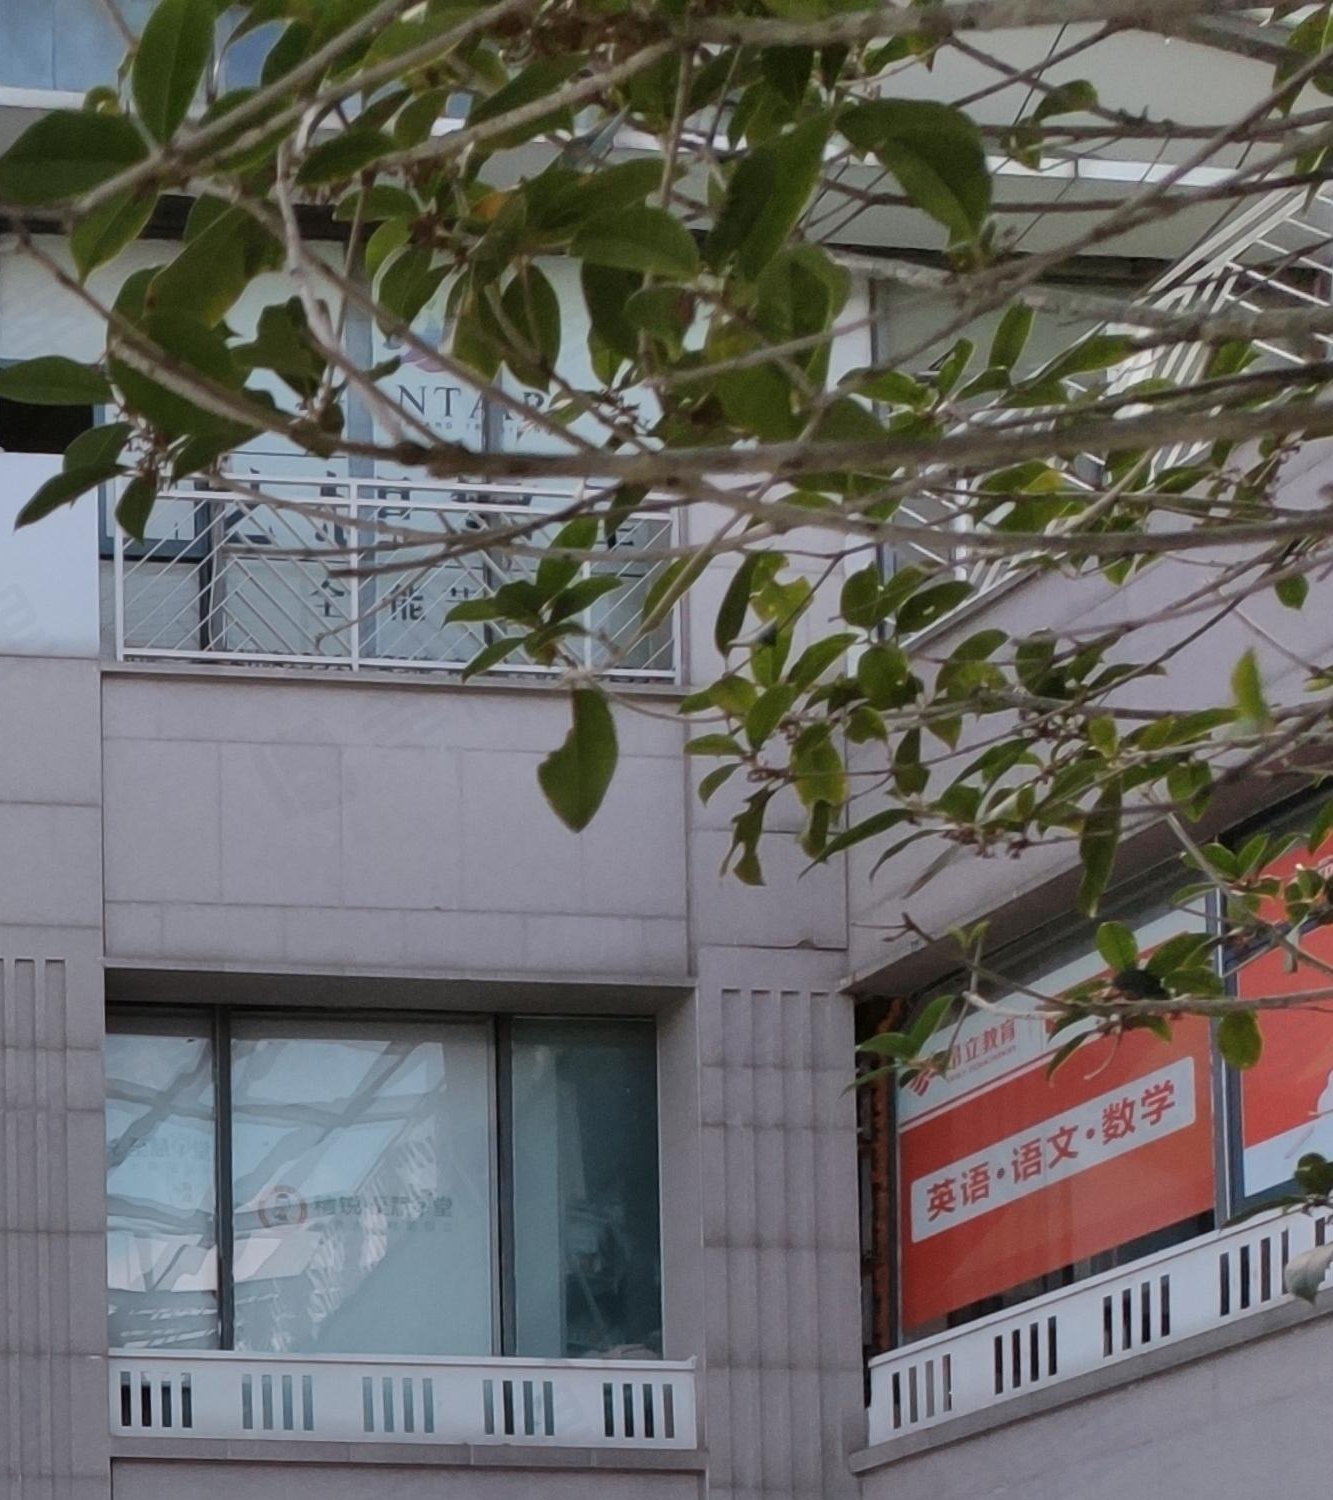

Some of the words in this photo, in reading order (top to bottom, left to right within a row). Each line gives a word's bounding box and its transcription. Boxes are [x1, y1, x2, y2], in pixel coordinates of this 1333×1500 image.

[926, 1079, 1176, 1222] 英语·语文·数学
